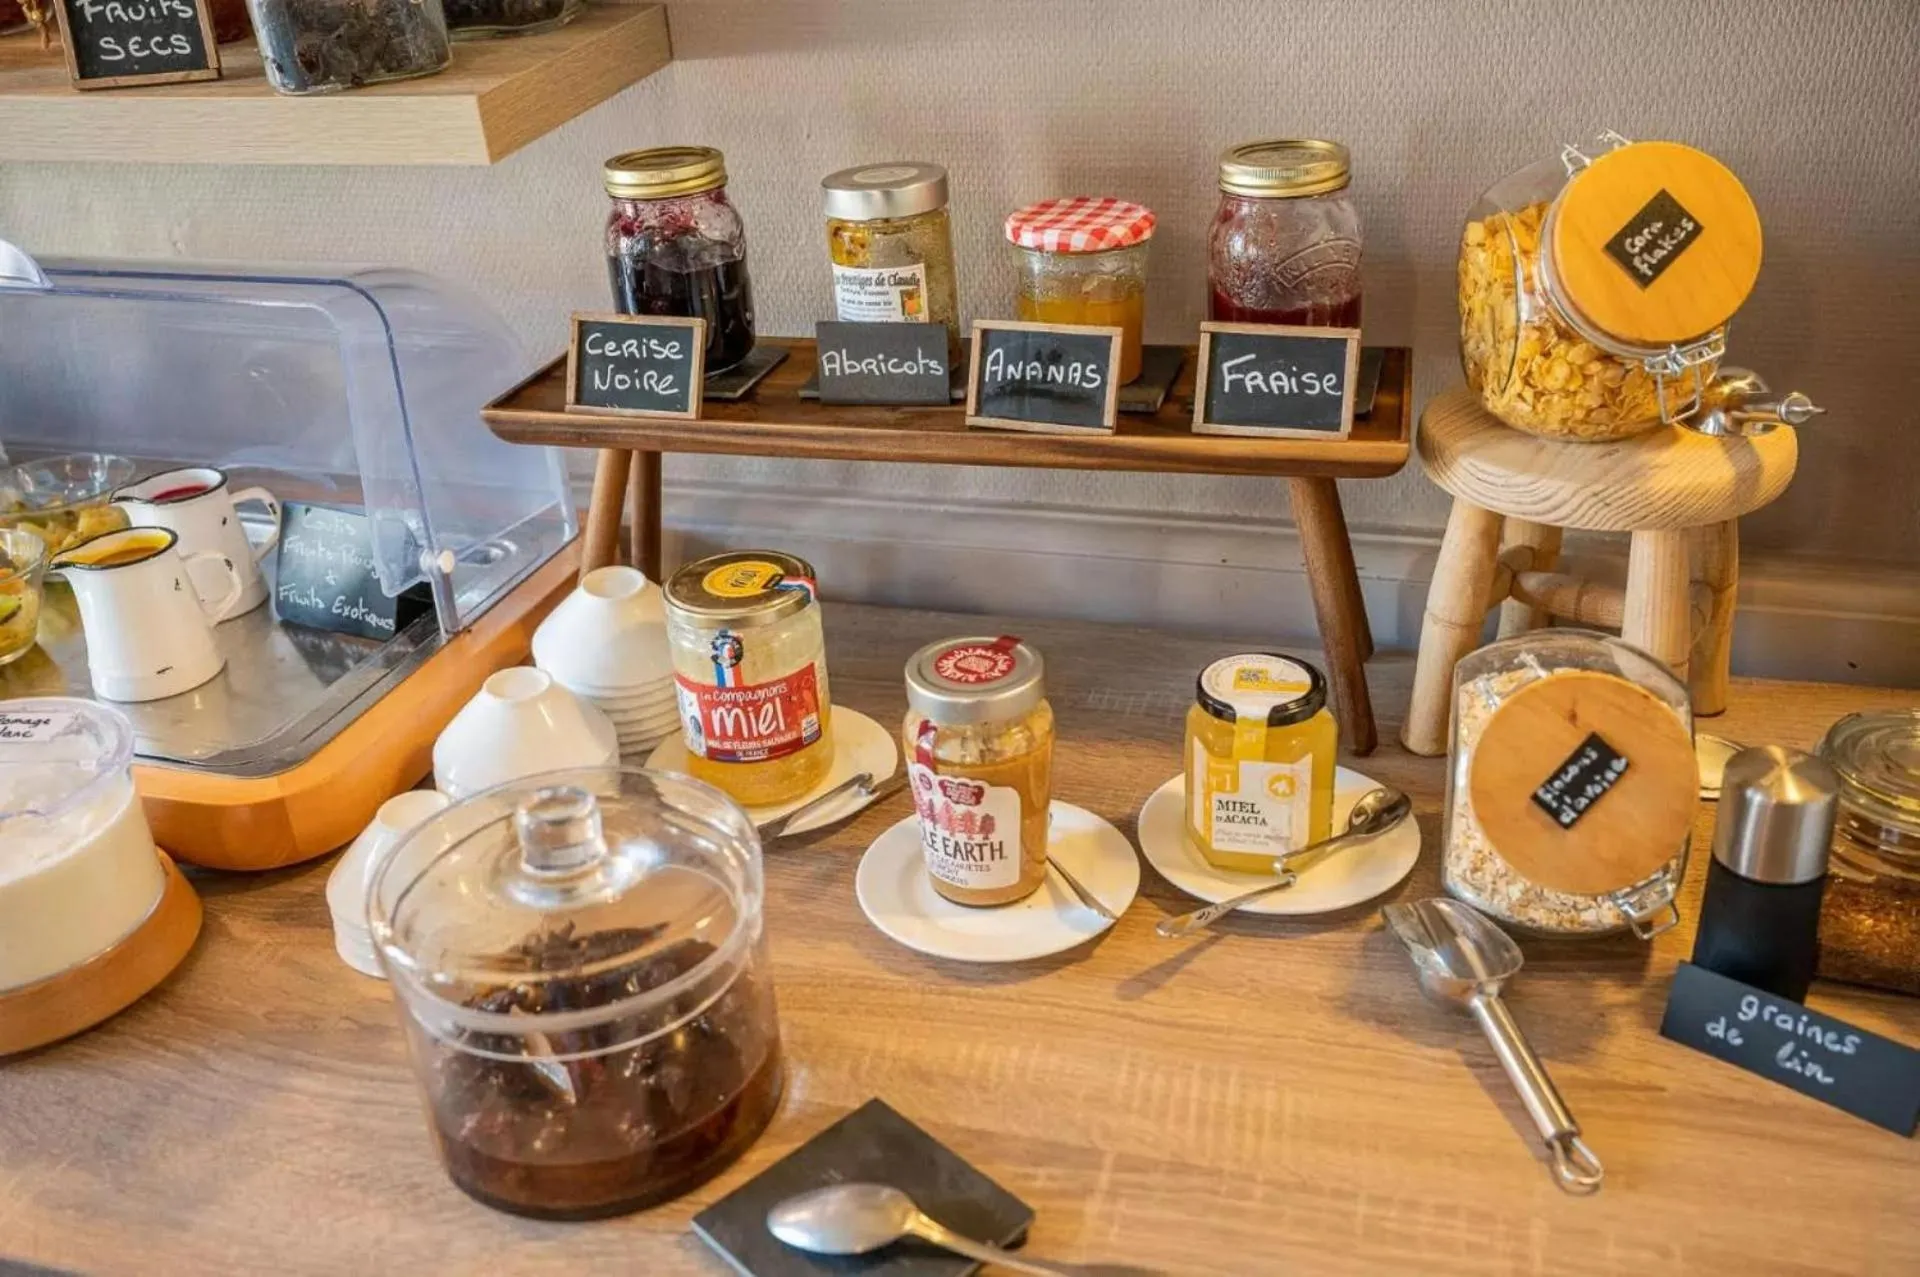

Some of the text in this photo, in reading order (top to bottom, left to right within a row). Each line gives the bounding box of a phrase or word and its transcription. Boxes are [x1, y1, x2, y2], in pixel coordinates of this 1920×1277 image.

[821, 347, 944, 376] Abricots
[984, 348, 1101, 388] ANANAS
[338, 544, 379, 579] Roug
[279, 583, 396, 631] Fruits Exotiques
[0, 726, 33, 738] lanc
[711, 697, 785, 738] miel
[1216, 799, 1260, 814] MIEL
[942, 836, 1003, 862] EARTH
[1737, 994, 1861, 1055] graines
[1705, 1016, 1835, 1085] de lin
